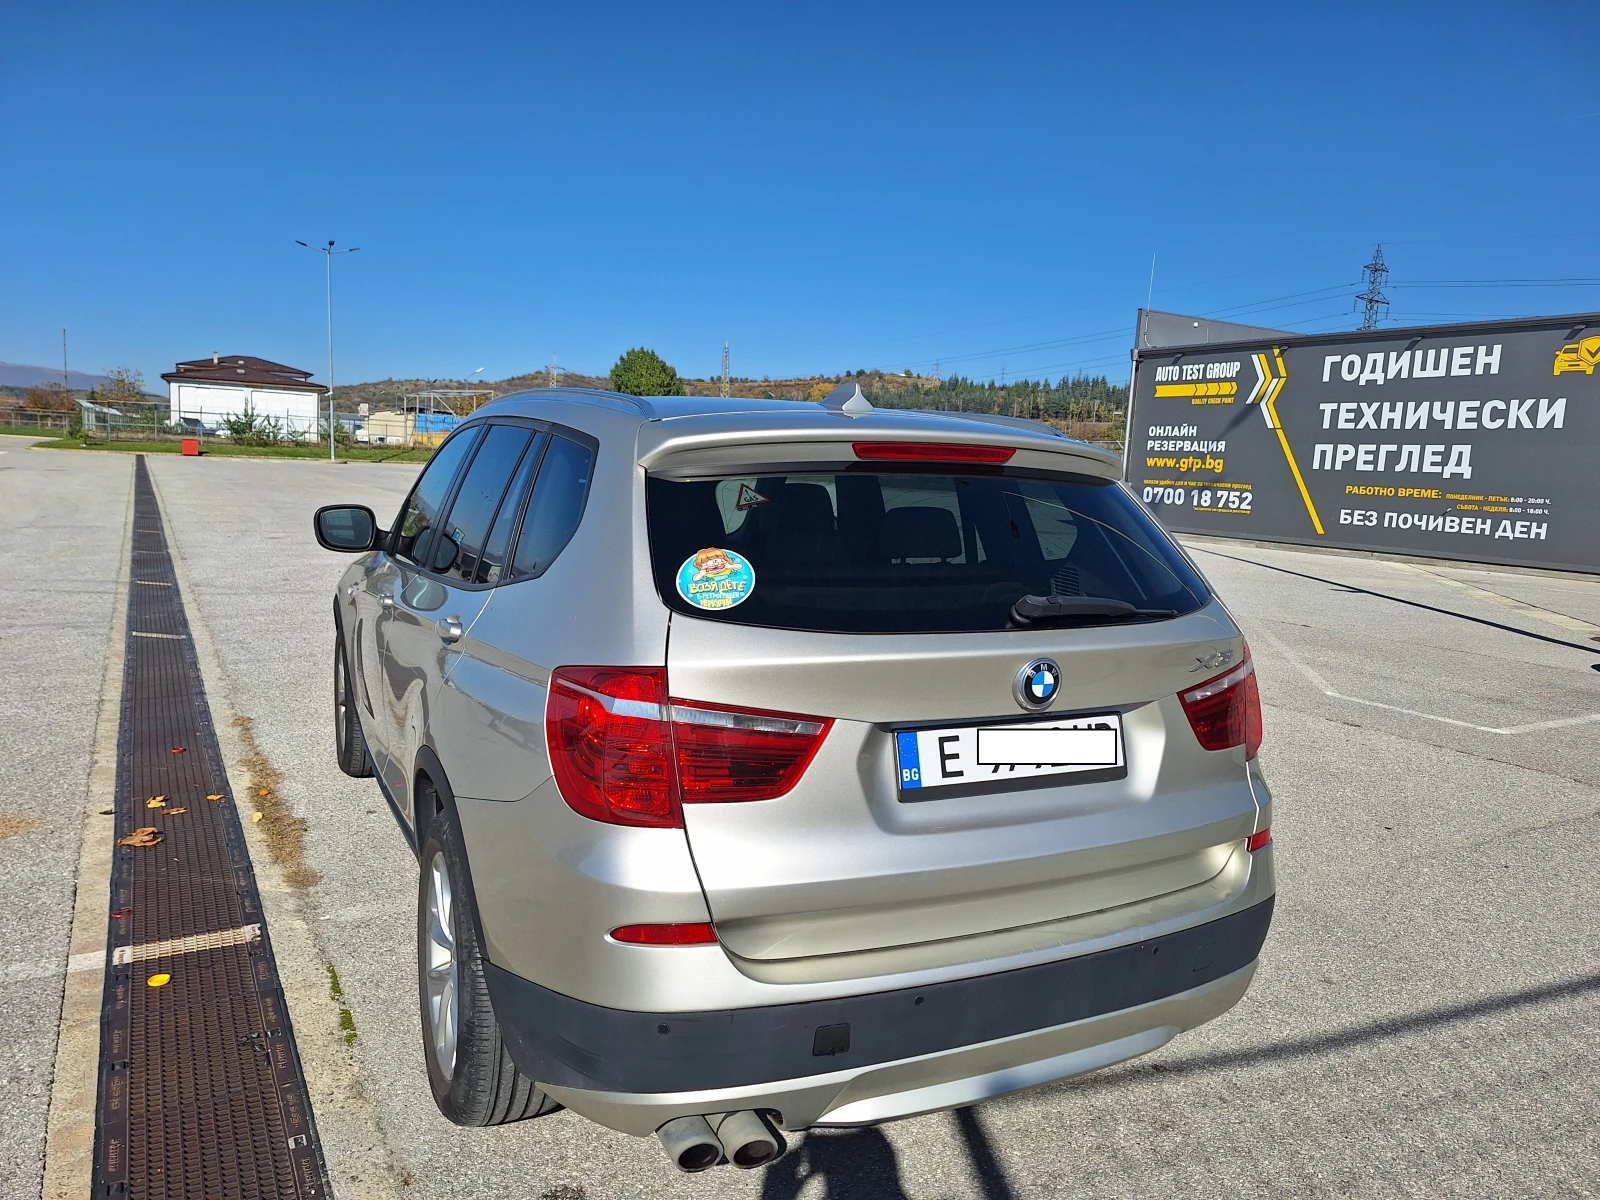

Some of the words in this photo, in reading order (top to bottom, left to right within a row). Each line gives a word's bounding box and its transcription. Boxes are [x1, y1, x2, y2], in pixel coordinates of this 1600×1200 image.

[1155, 366, 1180, 382] AUTO
[1182, 364, 1205, 380] TEST
[1206, 361, 1241, 379] GROUP
[1322, 344, 1502, 386] ГОДИШЕН
[1319, 397, 1567, 430] ТЕХНИЧЕСКИ
[1148, 423, 1198, 437] ОНЛАЙН
[1146, 440, 1226, 453] РЕЗЕРВАЦИЯ
[1146, 455, 1224, 473] www.gtp.bg
[1312, 443, 1473, 480] ПРЕГЛЕД
[1142, 486, 1185, 506] 0700
[1190, 489, 1212, 507] 18
[1216, 490, 1253, 510] 752
[1345, 485, 1395, 498] РАБОТНО
[1397, 488, 1442, 499] ВРЕМЕ:
[1339, 509, 1378, 526] БЕЗ
[1383, 512, 1492, 536] ПОЧИВЕН
[1495, 519, 1549, 541] ДЕН
[689, 581, 719, 594] ВОЗЯ
[719, 580, 747, 594] ДЕТЕ
[1028, 663, 1058, 679] BMW
[938, 735, 964, 778] E
[902, 768, 919, 782] BG
